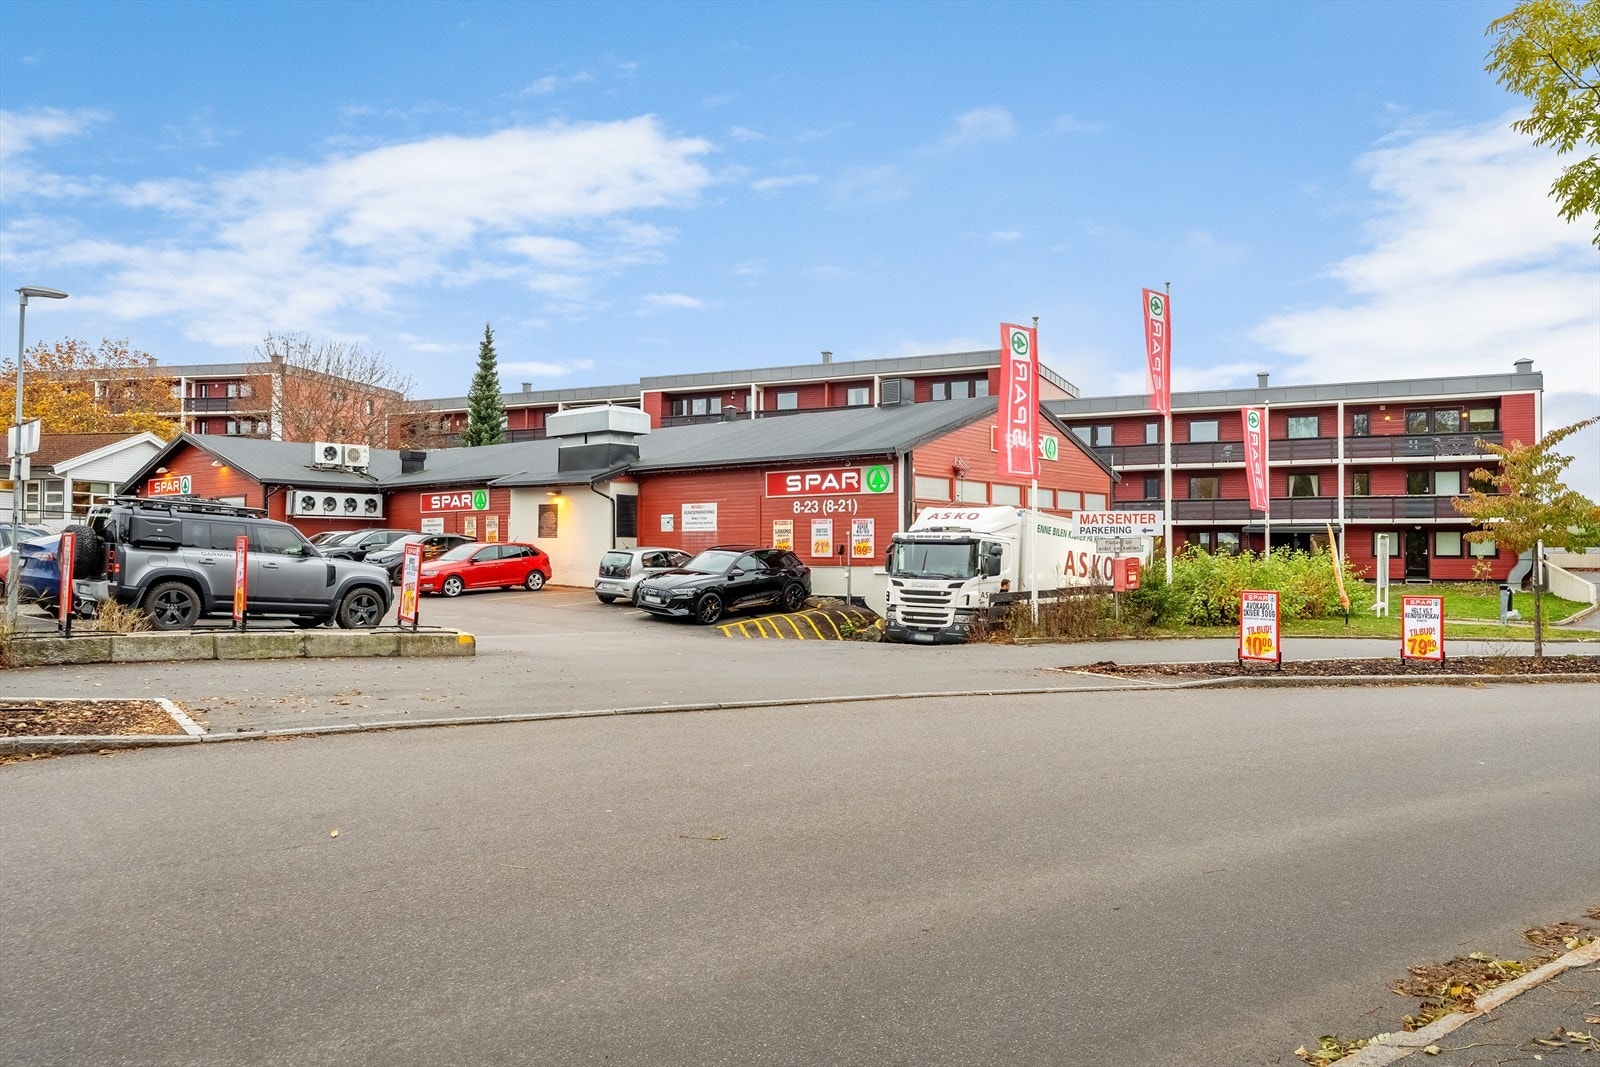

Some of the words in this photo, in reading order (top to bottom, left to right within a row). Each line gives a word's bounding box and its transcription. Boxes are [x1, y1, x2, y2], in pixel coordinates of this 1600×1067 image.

[154, 480, 180, 493] SPAR
[786, 472, 859, 492] SPAR
[431, 494, 472, 509] SPAR
[793, 500, 819, 514] 8-23
[823, 499, 858, 516] (8-21)
[927, 512, 980, 521] ASKO
[1079, 513, 1156, 525] MATSENTER
[1037, 524, 1052, 536] ENNE
[1053, 527, 1067, 539] BILEN
[1079, 525, 1132, 535] PARKERING
[1064, 550, 1114, 582] ASKO
[1246, 624, 1272, 635] TILBUD!
[1409, 627, 1436, 636] TILBUD!
